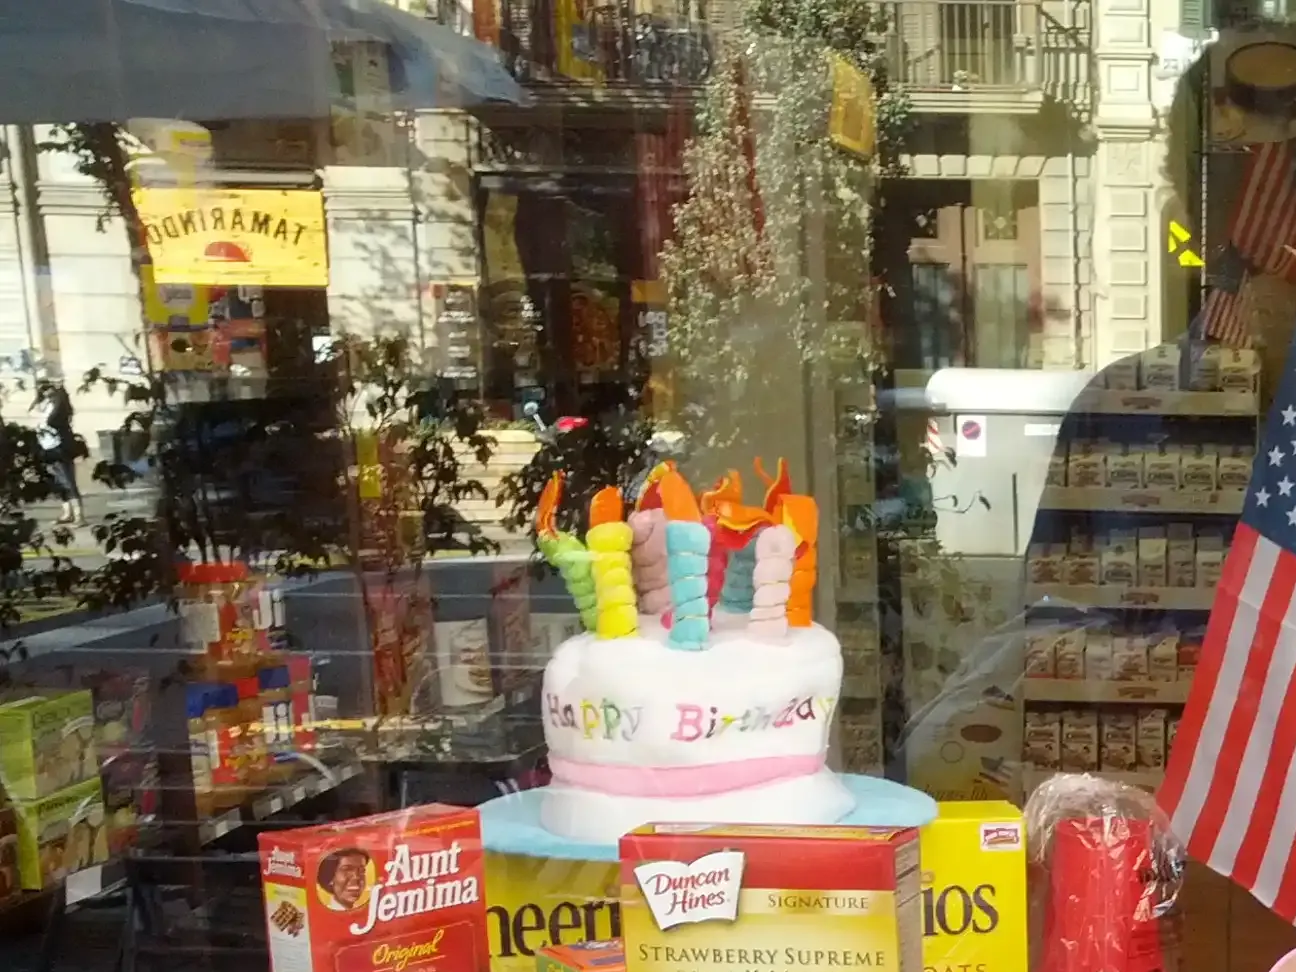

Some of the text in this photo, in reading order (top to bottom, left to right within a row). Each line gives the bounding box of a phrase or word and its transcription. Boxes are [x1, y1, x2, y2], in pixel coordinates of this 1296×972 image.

[252, 588, 286, 630] Ji
[547, 693, 835, 742] Happy Birthday
[384, 840, 462, 888] Aunt
[646, 866, 731, 897] Duncan
[349, 875, 480, 936] Jemima
[664, 888, 726, 917] Hines
[767, 894, 869, 910] SIGNATURE
[371, 928, 446, 972] Original
[639, 944, 886, 967] STRAWBERRY SUPREME
